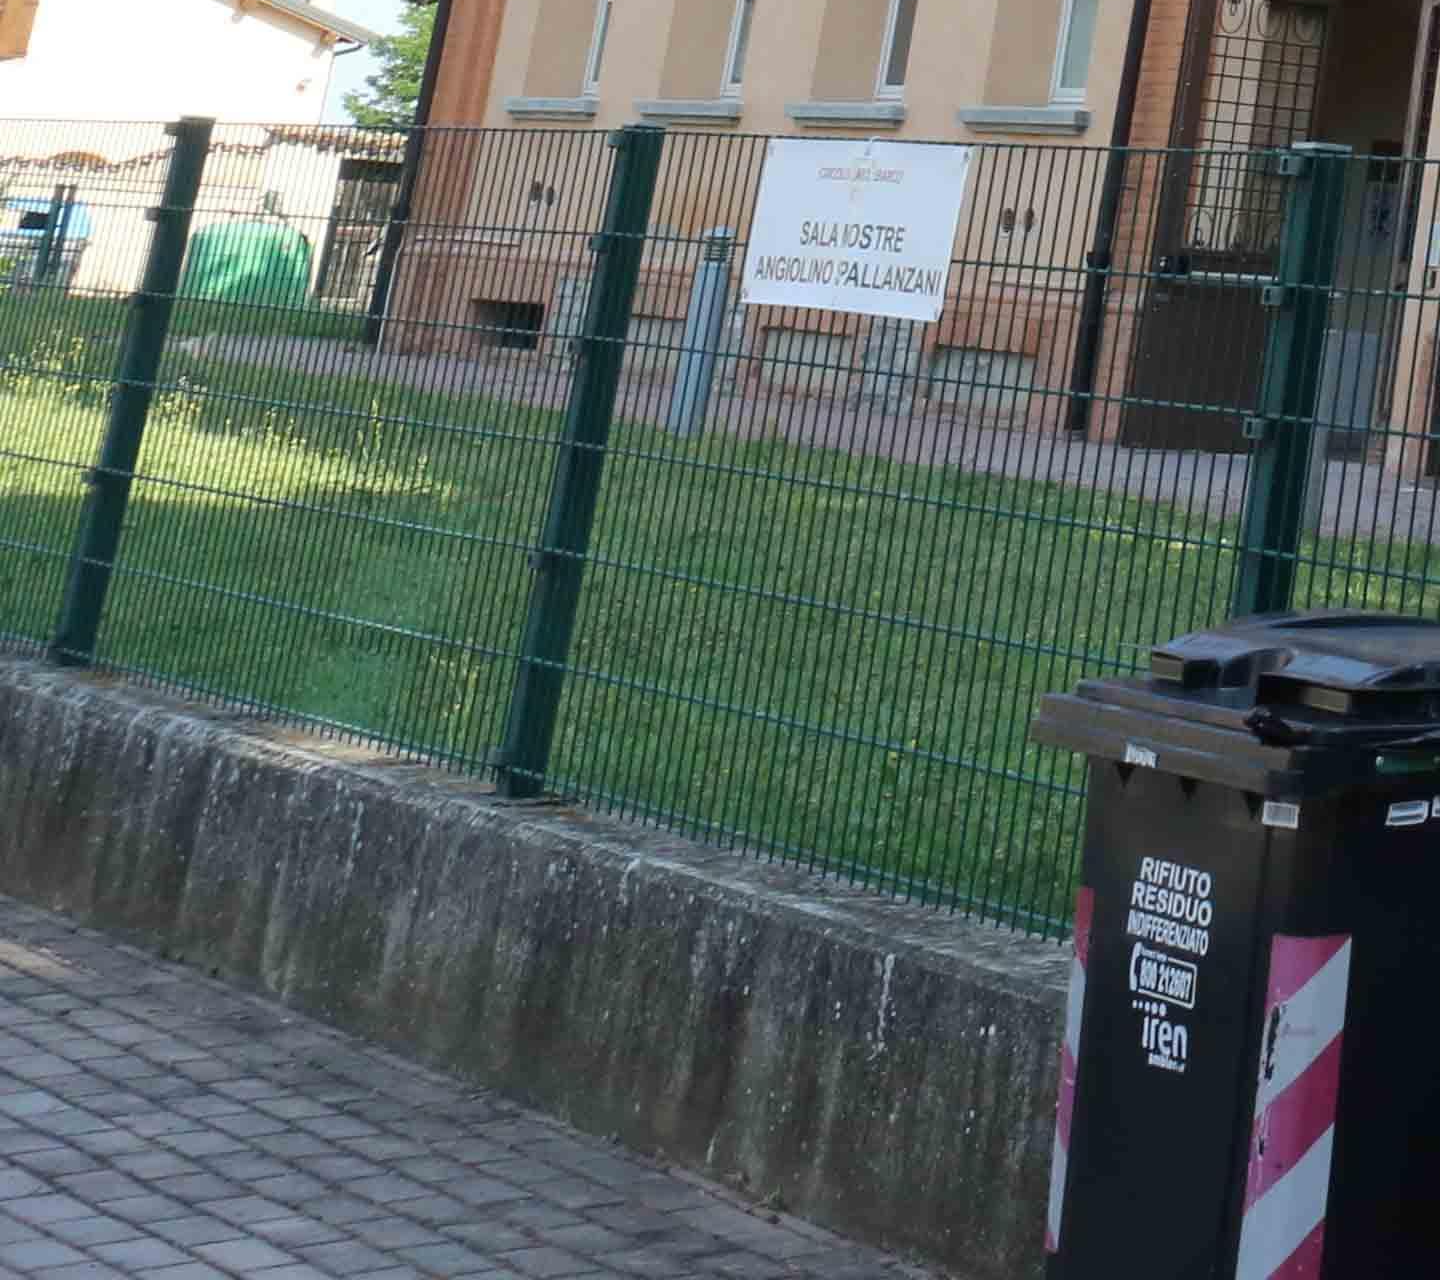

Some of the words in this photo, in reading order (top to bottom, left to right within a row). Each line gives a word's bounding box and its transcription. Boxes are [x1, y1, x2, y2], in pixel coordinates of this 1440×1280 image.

[800, 220, 838, 247] SALA
[755, 255, 834, 286] ANGIOLINO
[1140, 856, 1211, 899] RIFIUTO
[1131, 880, 1212, 927] RESIDUO
[1142, 1015, 1188, 1059] iren
